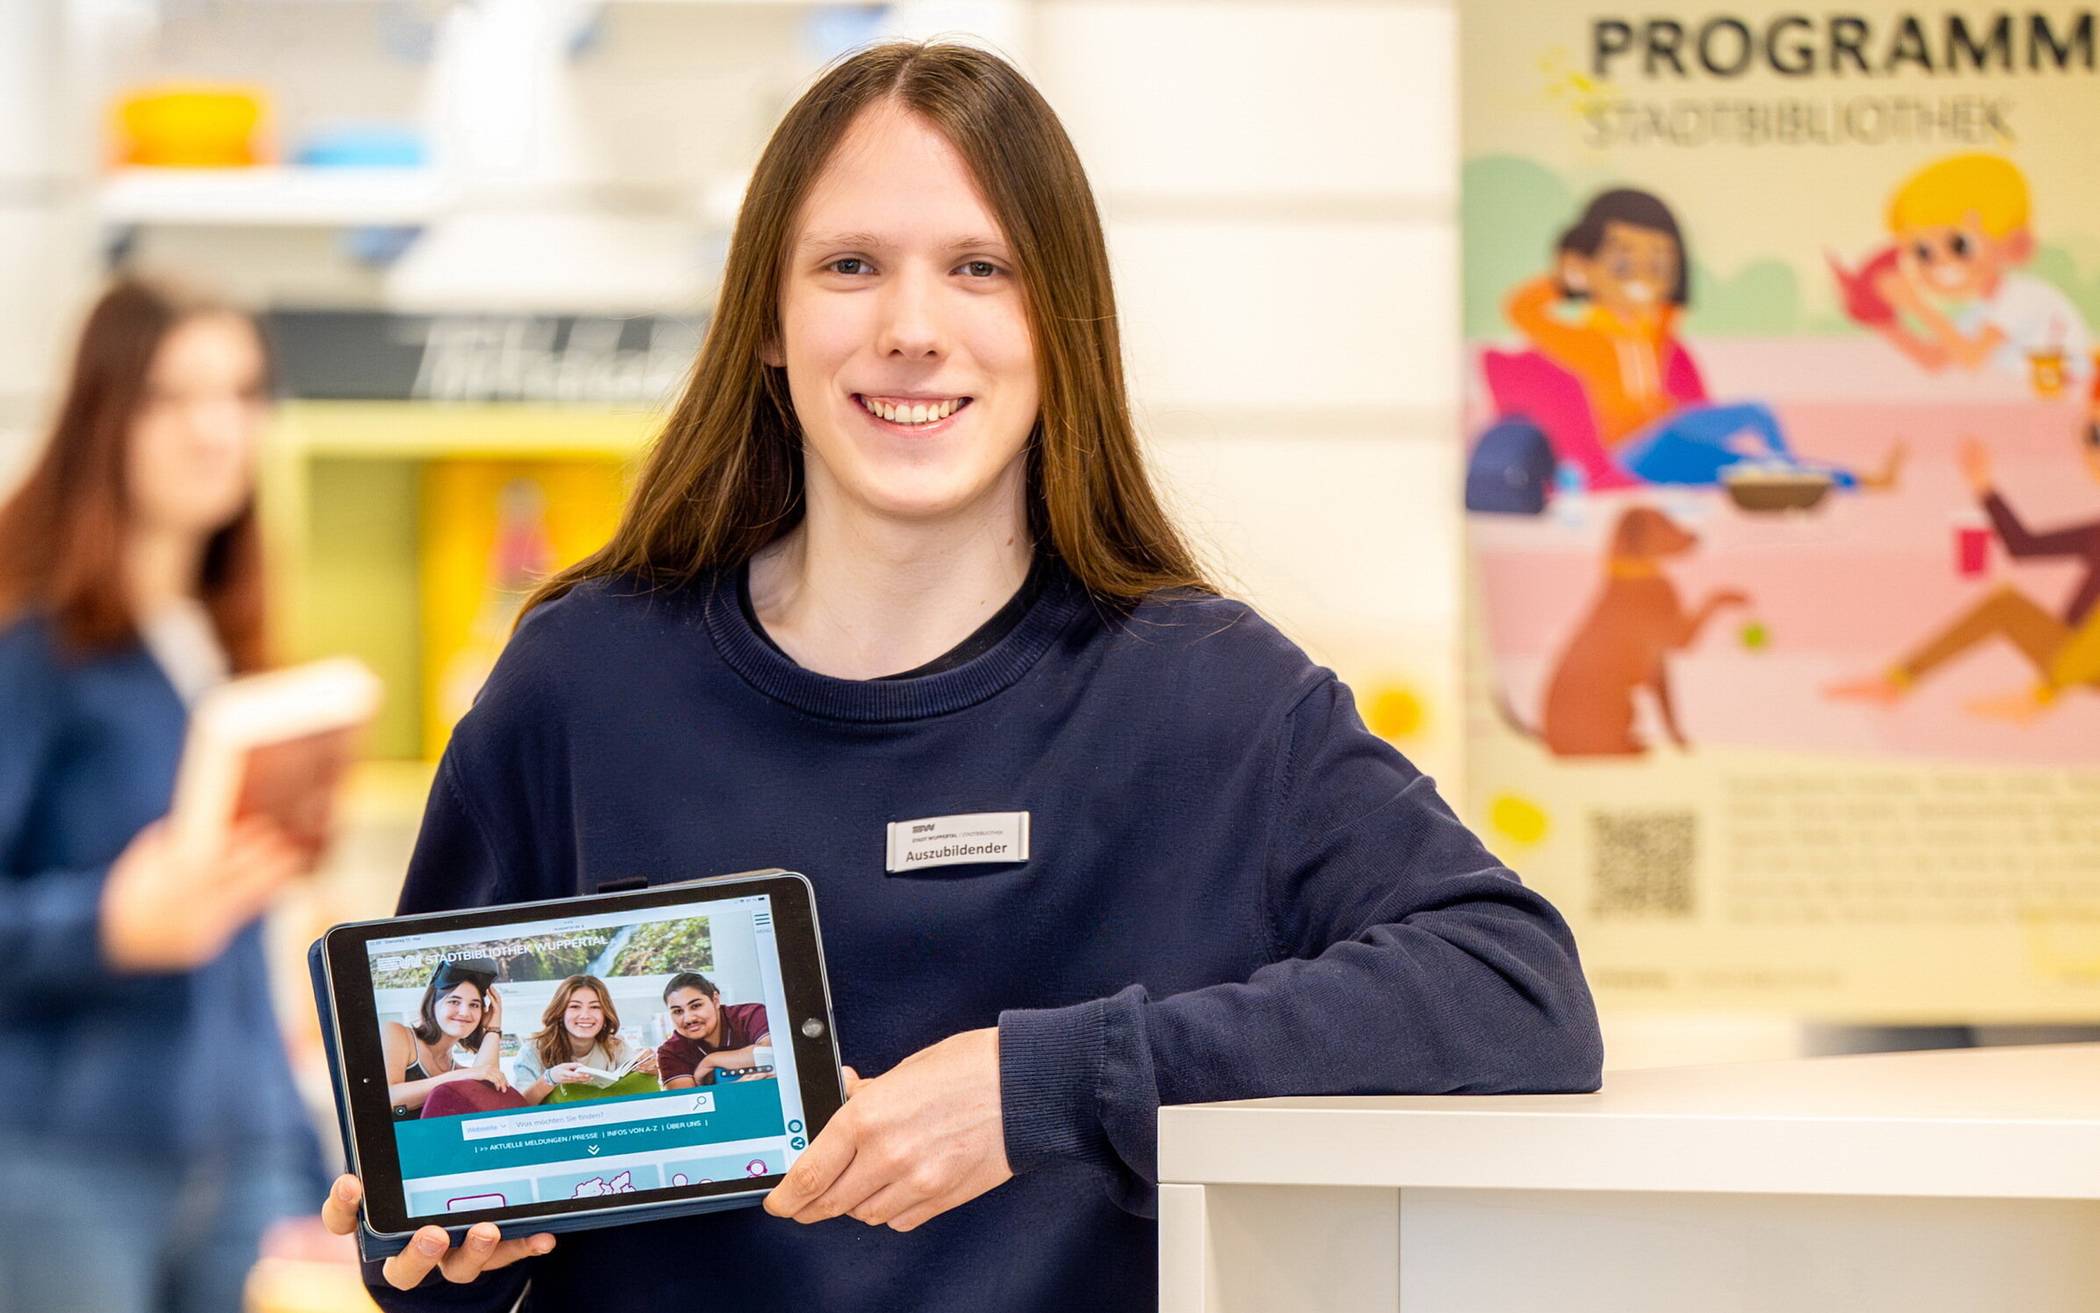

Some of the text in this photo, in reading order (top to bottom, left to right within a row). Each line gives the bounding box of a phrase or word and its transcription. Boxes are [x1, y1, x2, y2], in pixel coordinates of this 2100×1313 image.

[1590, 13, 2094, 78] PROGRAMM
[1583, 95, 2014, 148] STADTBIBLIOTHEK
[906, 843, 1007, 862] Auszubildender
[426, 935, 608, 964] STADTBIBLIOTHEK WUPPERTAL
[516, 1112, 604, 1128] Was möchten Sie finden?
[490, 1141, 523, 1150] AKTUELLE
[525, 1136, 568, 1146] MELDUNGEN
[572, 1132, 598, 1141] PRESSE
[606, 1128, 628, 1137] INFOS
[628, 1126, 645, 1135] VON
[666, 1120, 686, 1130] ÜBER
[686, 1120, 702, 1128] UNS
